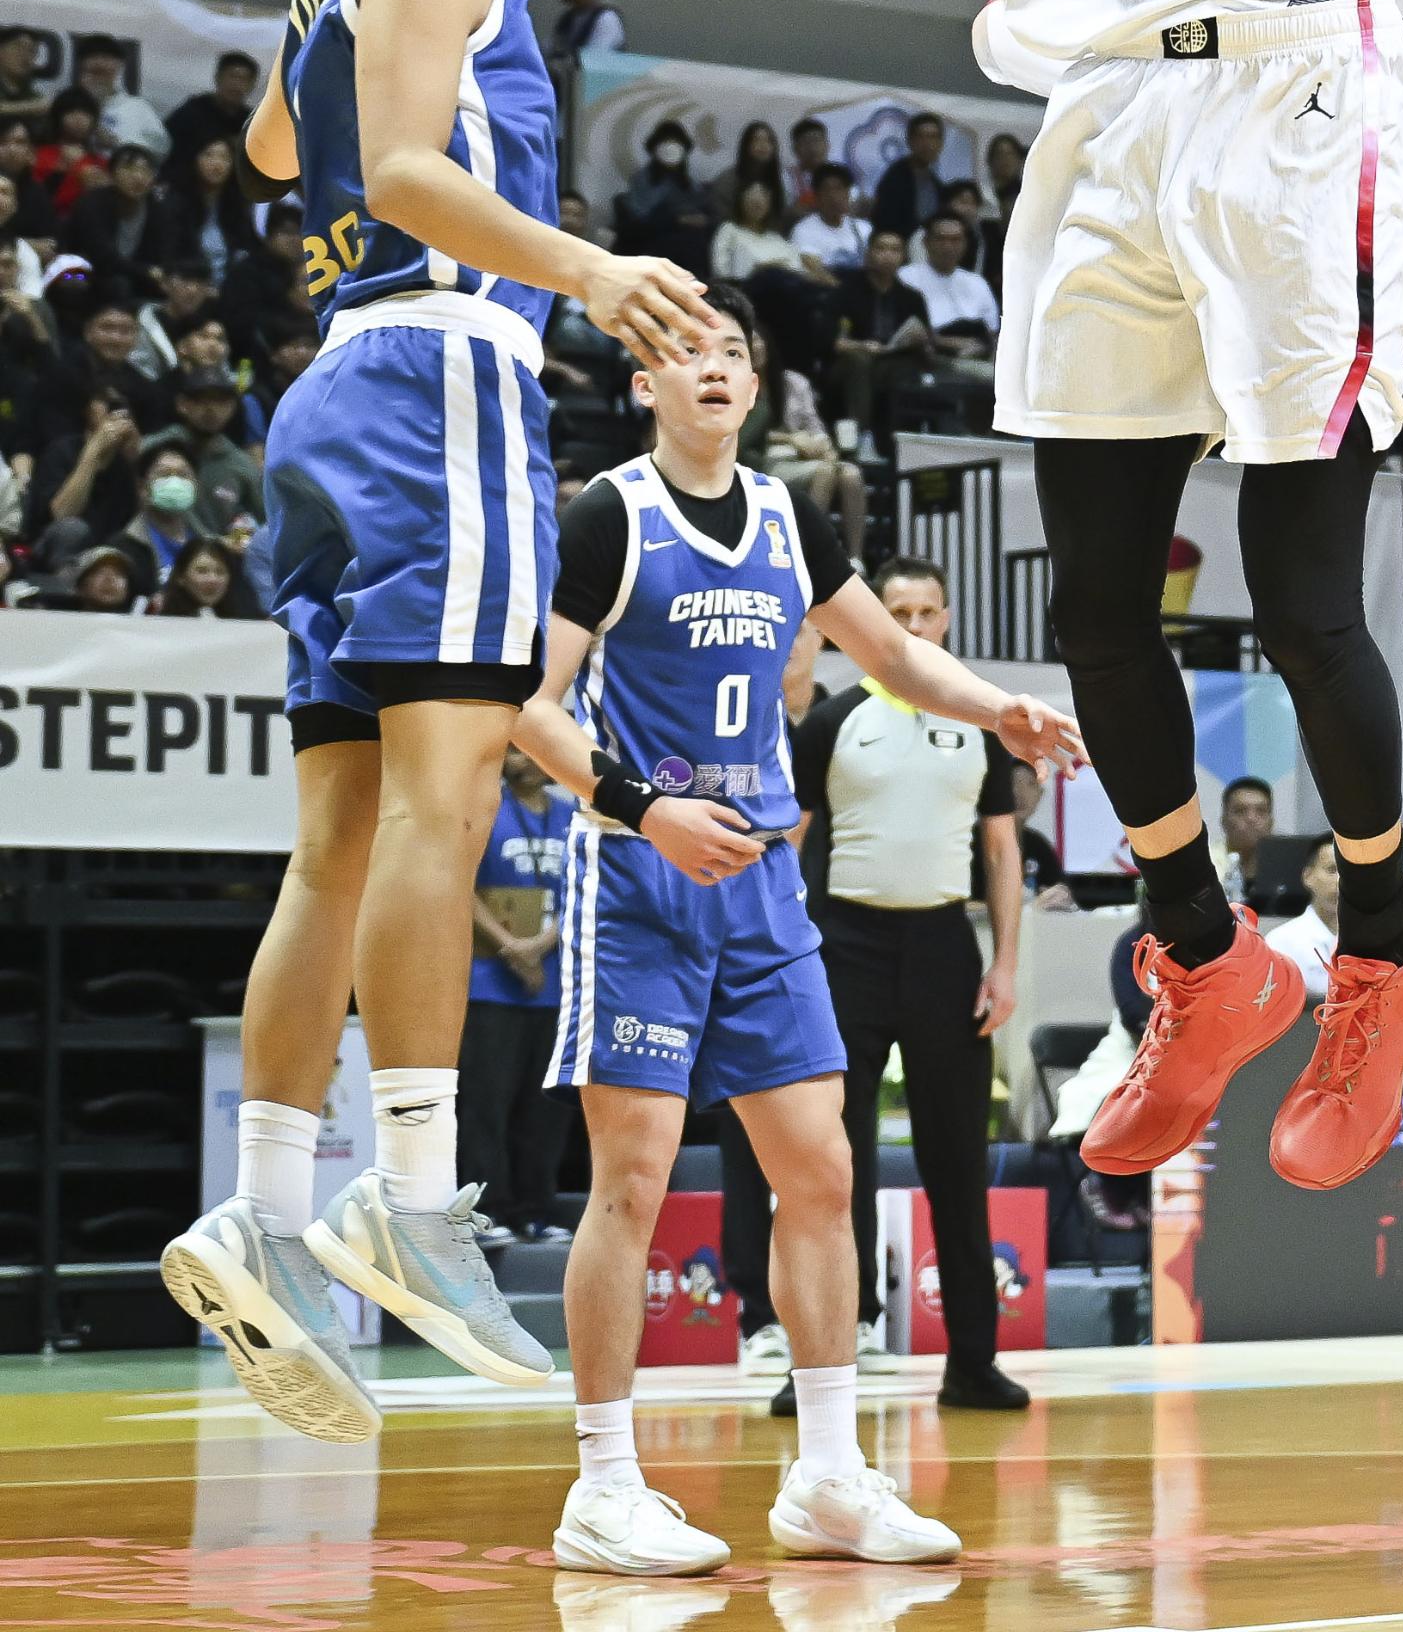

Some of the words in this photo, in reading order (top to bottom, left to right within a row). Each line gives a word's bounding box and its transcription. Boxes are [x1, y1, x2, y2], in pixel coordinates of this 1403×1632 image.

[668, 588, 787, 625] CHINESE
[687, 618, 777, 651] TAIPEI
[714, 674, 751, 738] 0
